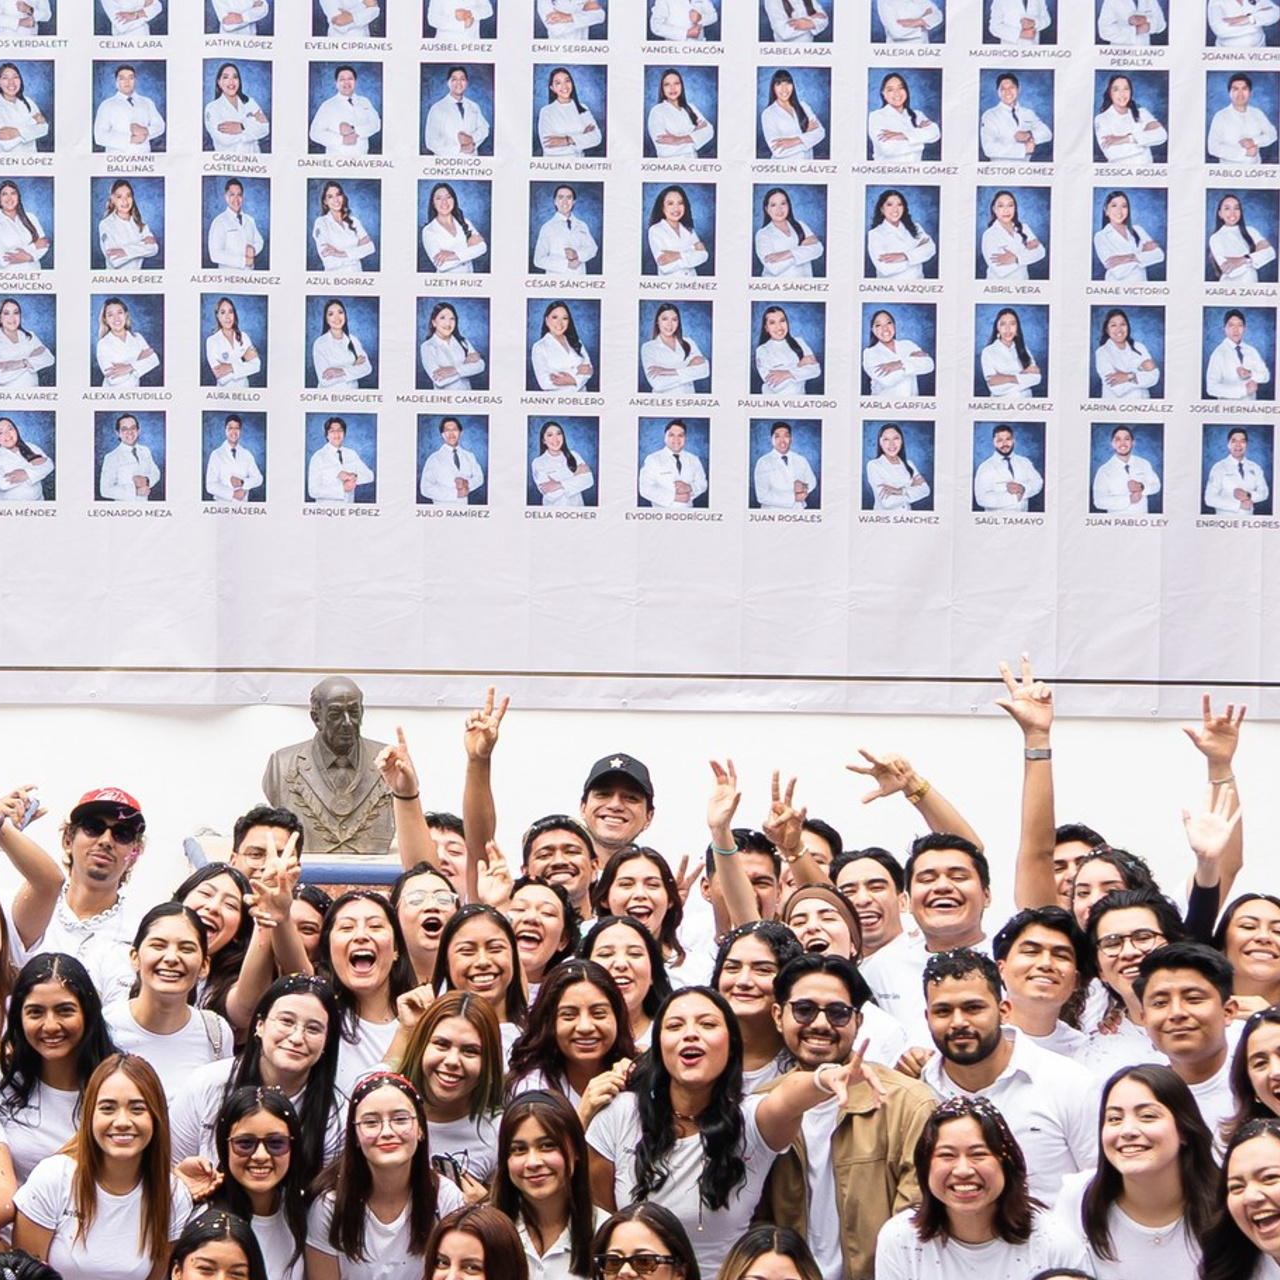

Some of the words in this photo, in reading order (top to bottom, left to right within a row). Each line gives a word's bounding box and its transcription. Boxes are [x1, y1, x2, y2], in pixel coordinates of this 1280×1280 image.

[12, 40, 68, 48] VERDALETT
[641, 46, 680, 54] YANDEL
[682, 46, 724, 54] CHACÓN
[760, 47, 801, 55] ISABELA
[530, 162, 572, 170] PAULINA
[977, 166, 1016, 175] NÉSTOR
[1018, 167, 1054, 176] GÓMEZ
[1094, 168, 1133, 176] JESSICA
[132, 275, 162, 284] PÉREZ
[525, 279, 557, 288] CÉSAR
[559, 280, 605, 289] SÁNCHEZ
[748, 283, 780, 291] KARLA
[783, 282, 829, 291] SÁNCHEZ
[983, 286, 1013, 294] ABRIL
[1015, 286, 1041, 294] VERA
[82, 392, 116, 400] ALEXIA
[118, 392, 172, 400] ASTUDILLO
[738, 399, 780, 408] PAULINA
[303, 508, 346, 517] ENRIQUE
[349, 507, 380, 516] PÉREZ
[665, 512, 723, 521] RODRÍGUEZ
[975, 517, 1000, 525] SAÚL
[1003, 517, 1044, 526] TAMAYO
[1086, 518, 1111, 526] JUAN
[1151, 519, 1169, 527] LEY
